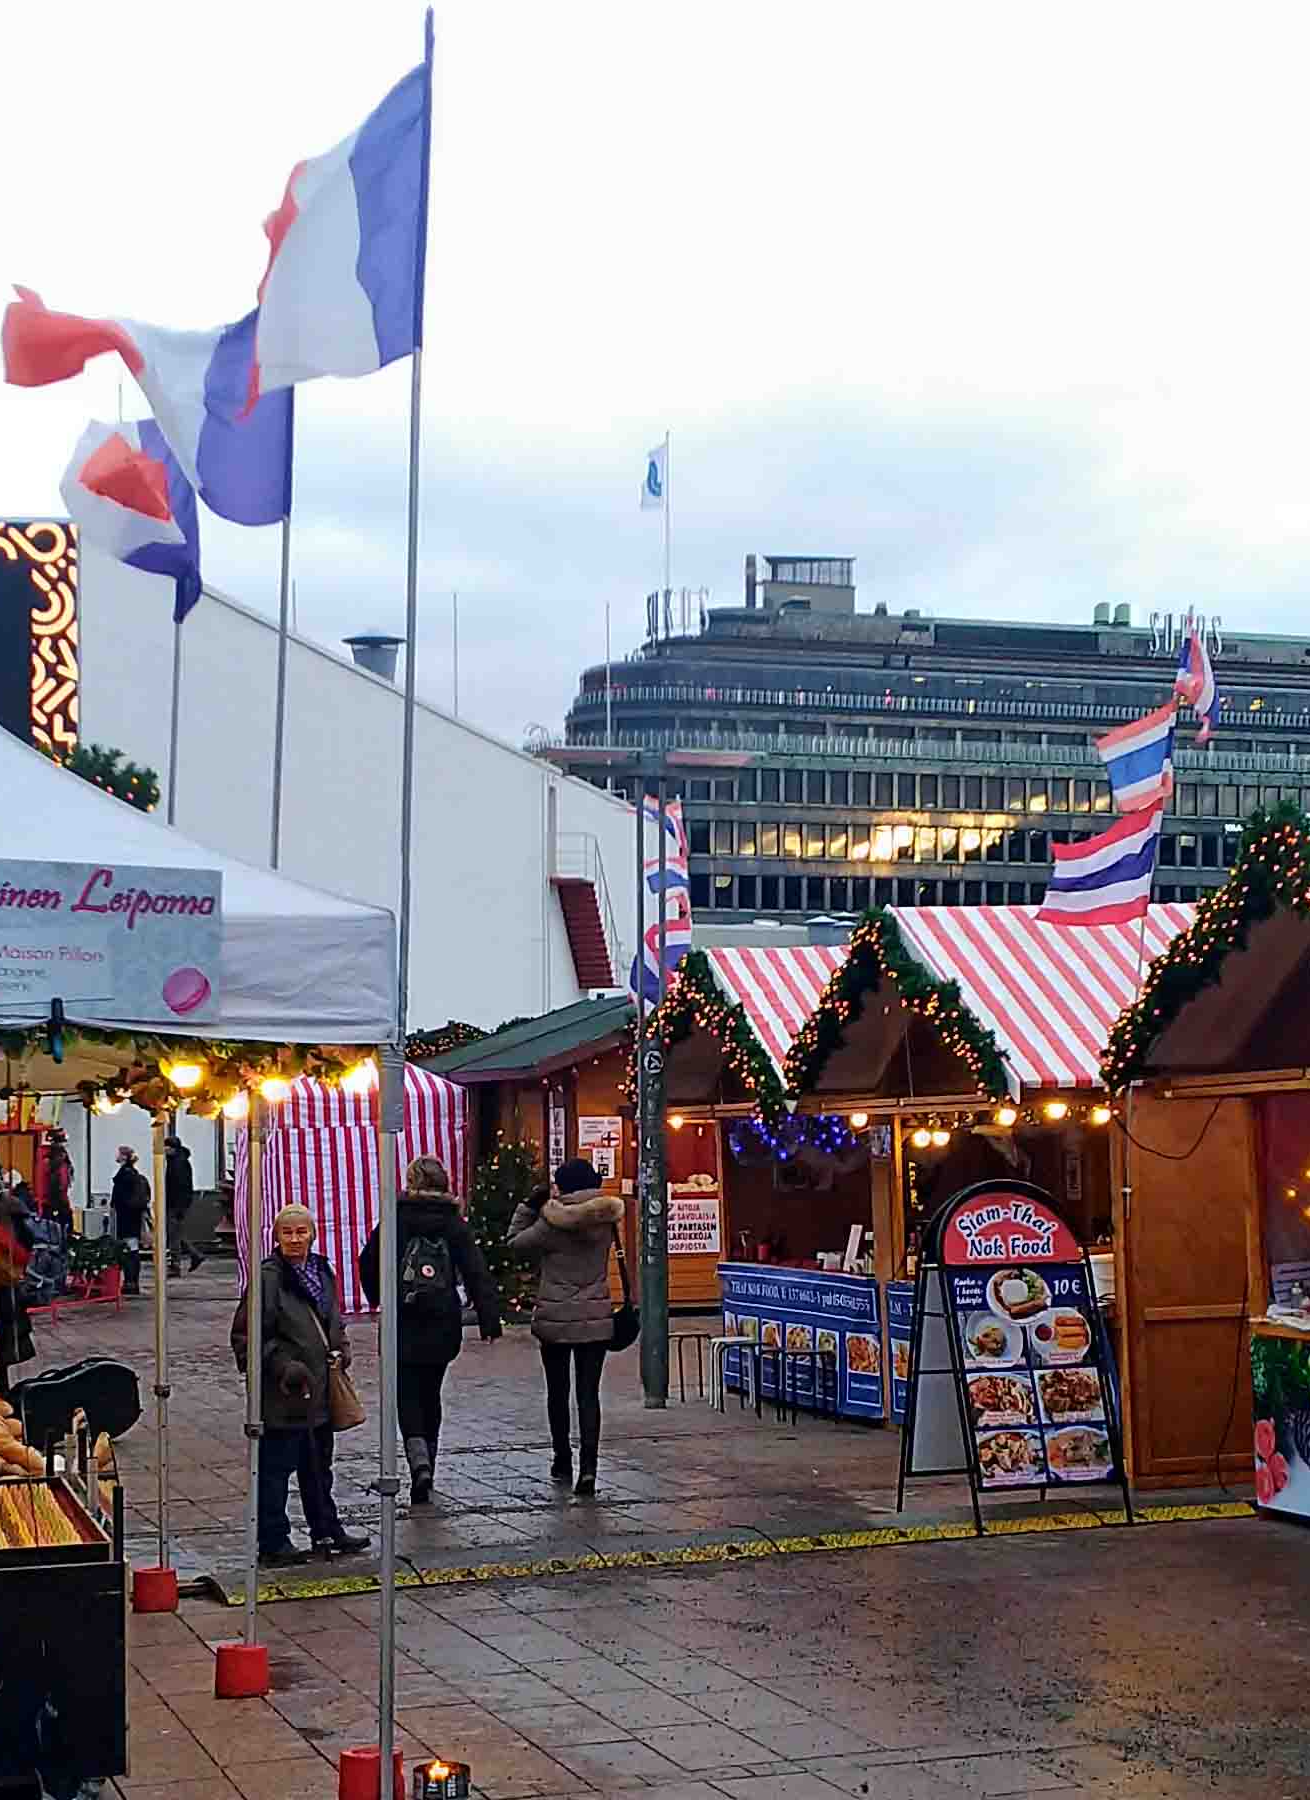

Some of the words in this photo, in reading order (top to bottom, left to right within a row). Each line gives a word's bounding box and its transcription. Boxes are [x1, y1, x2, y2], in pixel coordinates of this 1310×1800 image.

[957, 1202, 1057, 1238] Siam-Thai
[668, 1232, 712, 1241] LAKUKKOJA
[668, 1243, 707, 1251] UOPIOSTA
[968, 1238, 1005, 1257] Nok
[1010, 1237, 1053, 1256] Food
[1053, 1280, 1070, 1295] 10
